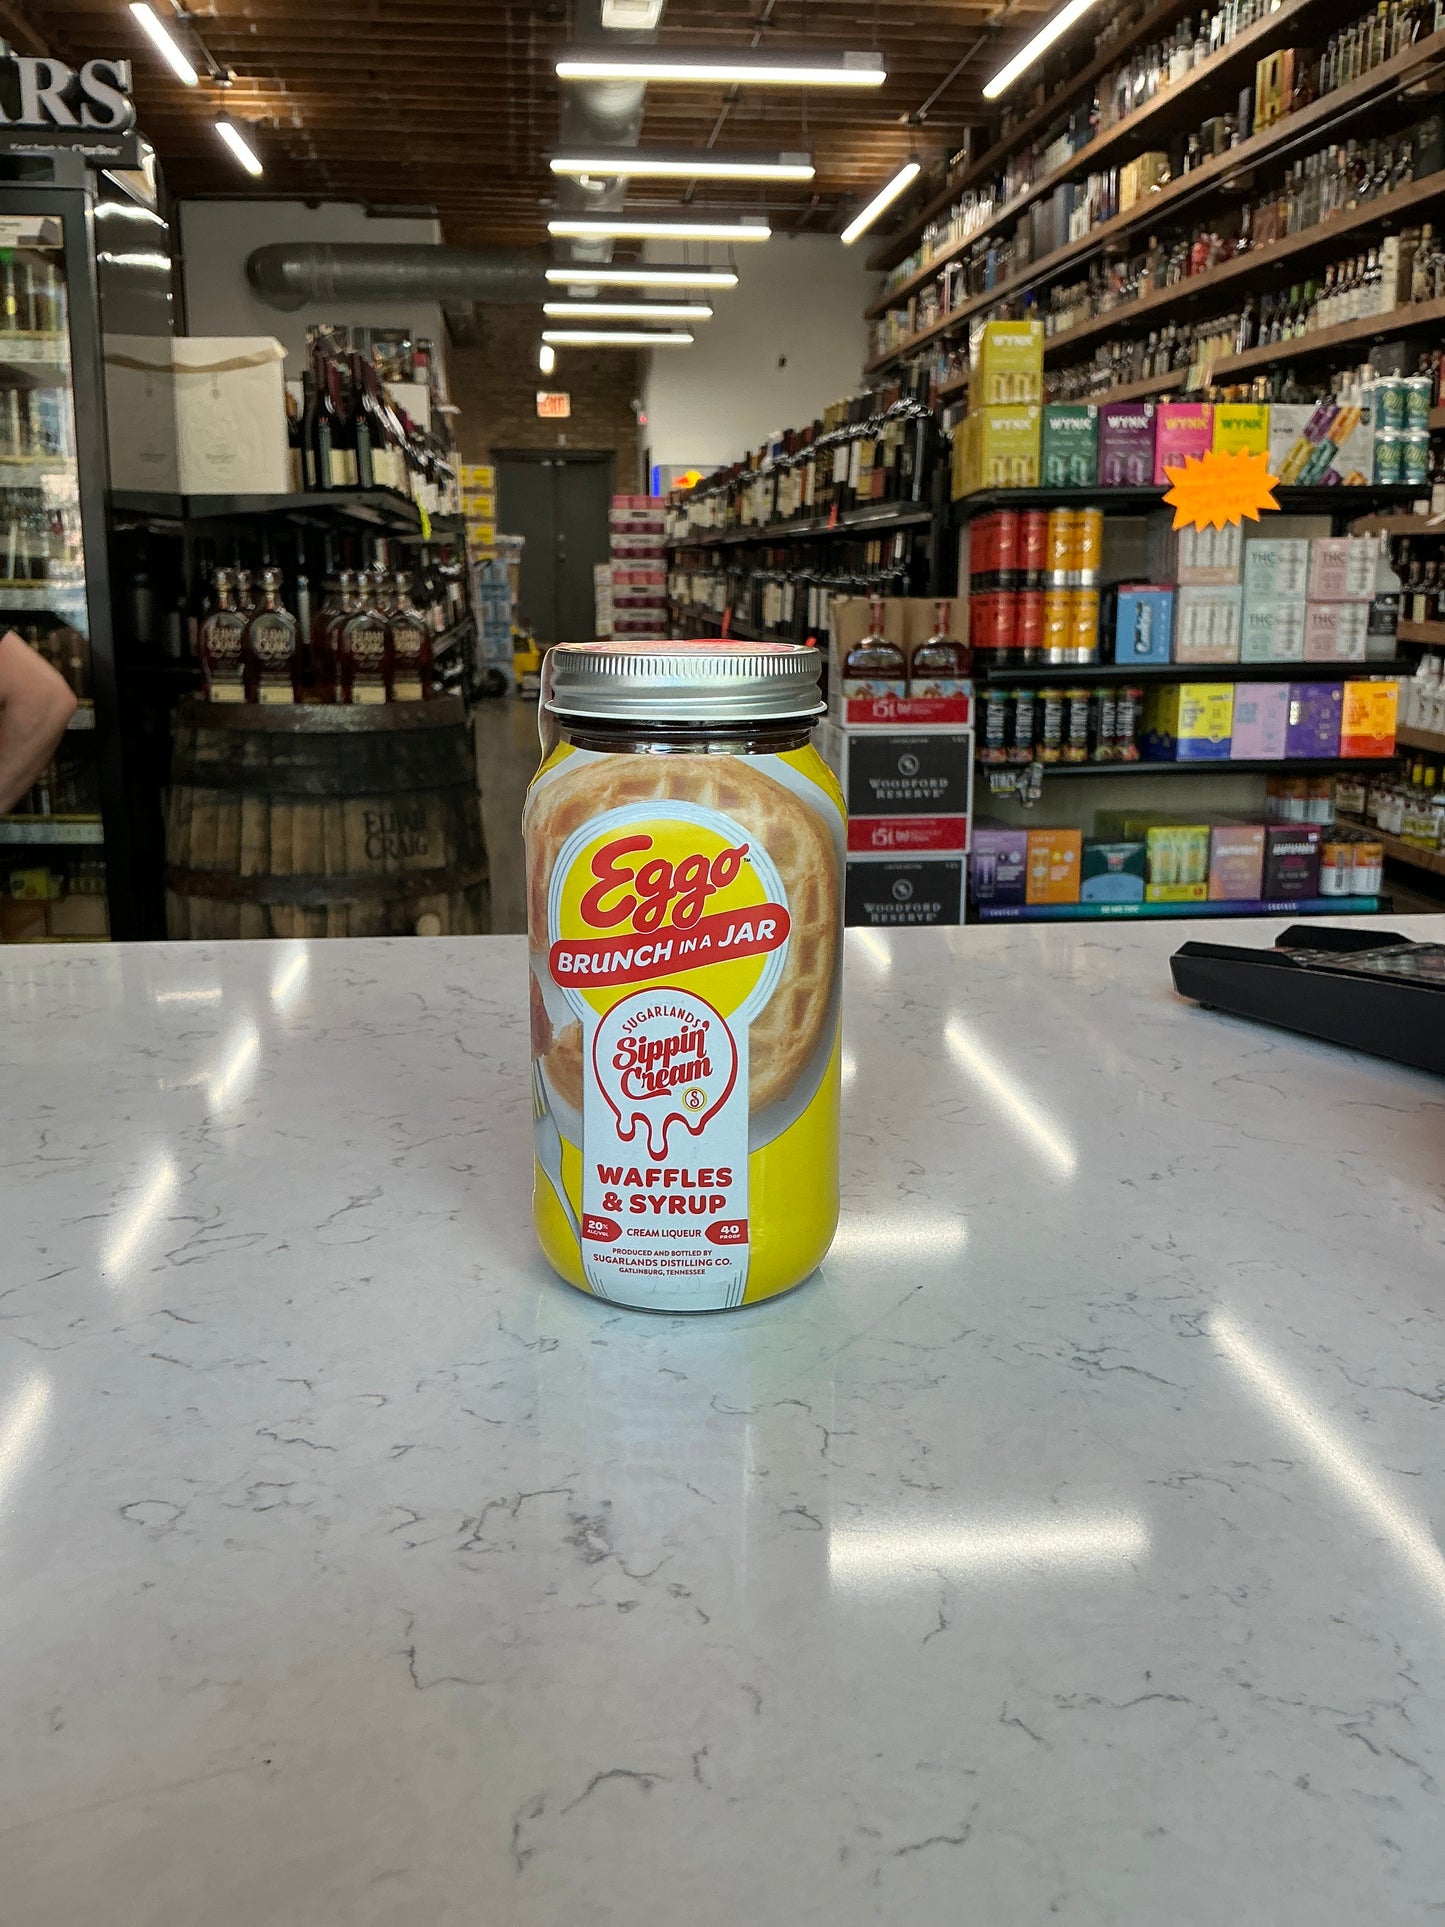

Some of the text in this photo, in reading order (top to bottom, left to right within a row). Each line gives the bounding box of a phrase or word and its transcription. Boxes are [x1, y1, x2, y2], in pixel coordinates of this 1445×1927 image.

[0, 57, 136, 129] RS
[992, 334, 1034, 348] WYNK
[990, 418, 1032, 431] WYNK
[1049, 416, 1093, 431] WYNK
[1107, 415, 1149, 430] WYNK
[1164, 416, 1209, 431] WYNK
[1220, 416, 1263, 430] WYNK
[1252, 551, 1276, 566] THC
[1322, 551, 1346, 564] THC
[1250, 614, 1273, 626] THC
[1312, 614, 1336, 626] THC
[869, 778, 949, 789] WOODFORD
[876, 788, 944, 800] RESERVE
[580, 834, 750, 933] Eggo
[863, 902, 942, 913] WOODFORD
[870, 912, 938, 923] RESERVE
[557, 918, 777, 975] BRUNCH IN A JAR
[622, 1005, 701, 1034] SUGARLANDS
[612, 1020, 710, 1072] Sippin'
[620, 1057, 713, 1101] Cream
[597, 1163, 733, 1189] WAFFLES
[602, 1191, 727, 1215] & SYRUP
[587, 1219, 609, 1231] 20%
[720, 1224, 740, 1235] 40
[626, 1228, 702, 1240] CREAM LIQUEUR
[612, 1247, 653, 1257] PRODUCED
[593, 1253, 733, 1268] SUGARLANDS DISTILLING CO.
[618, 1267, 706, 1277] GATLINBURG, TENNESSEE
